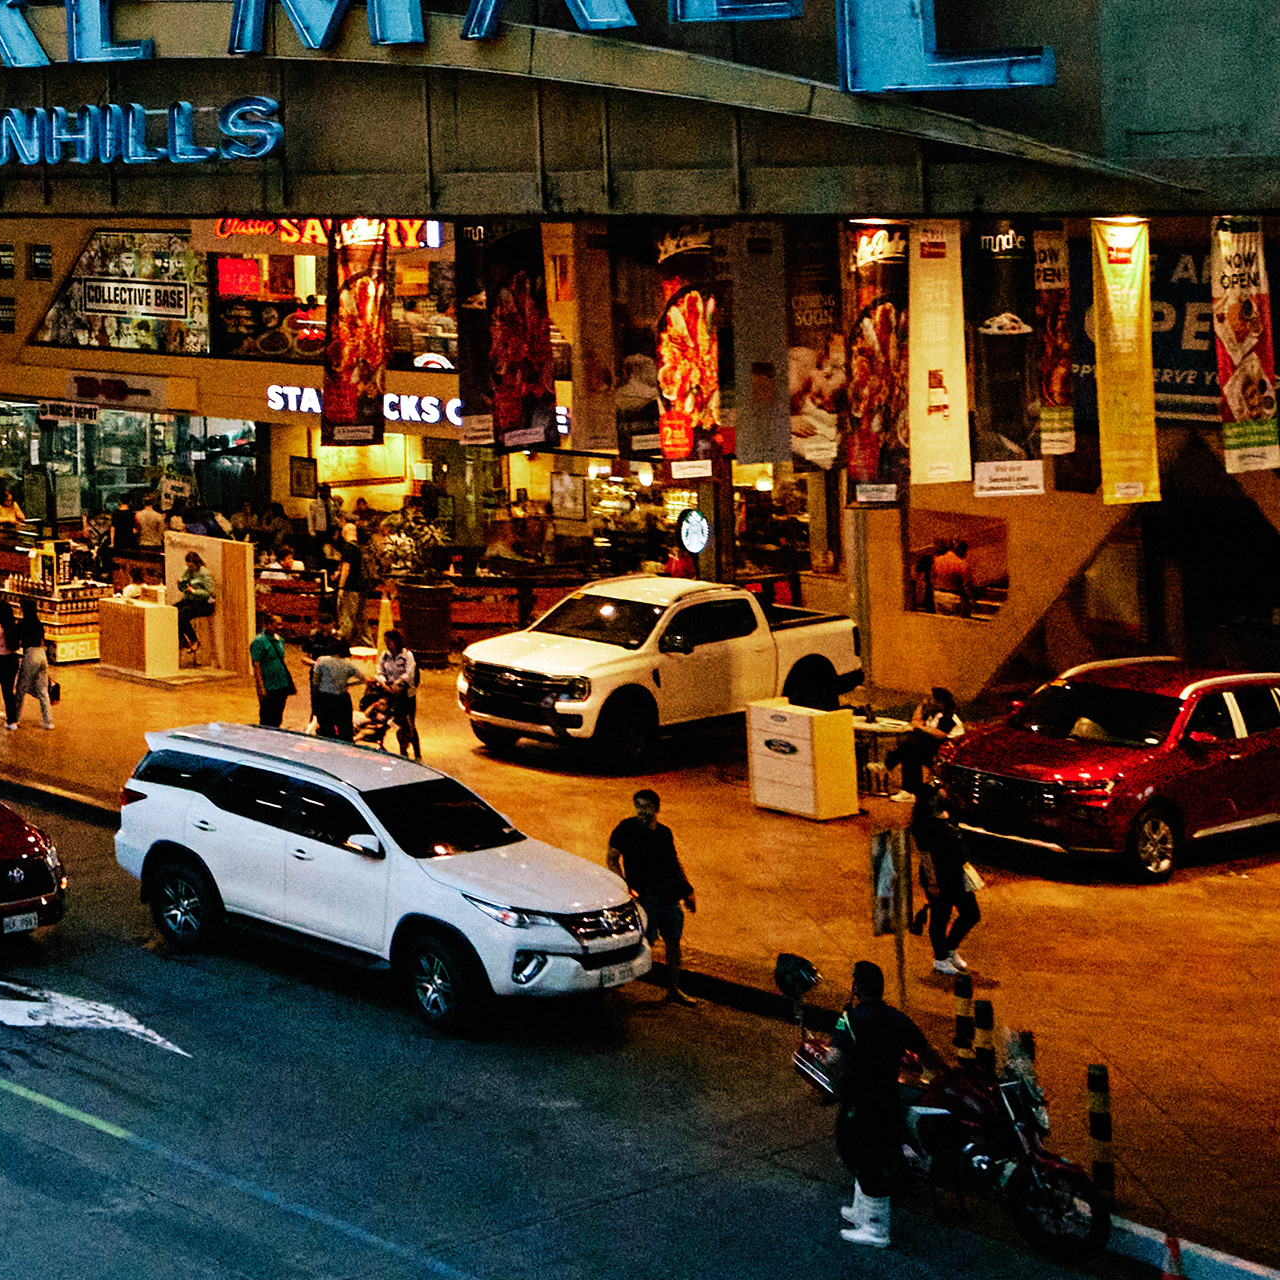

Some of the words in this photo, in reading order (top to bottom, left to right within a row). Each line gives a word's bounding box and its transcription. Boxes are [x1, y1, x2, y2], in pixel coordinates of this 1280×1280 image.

[214, 218, 277, 238] Classic
[87, 285, 151, 306] COLLECTIVE
[154, 288, 183, 309] BASE
[267, 384, 441, 424] STACKS
